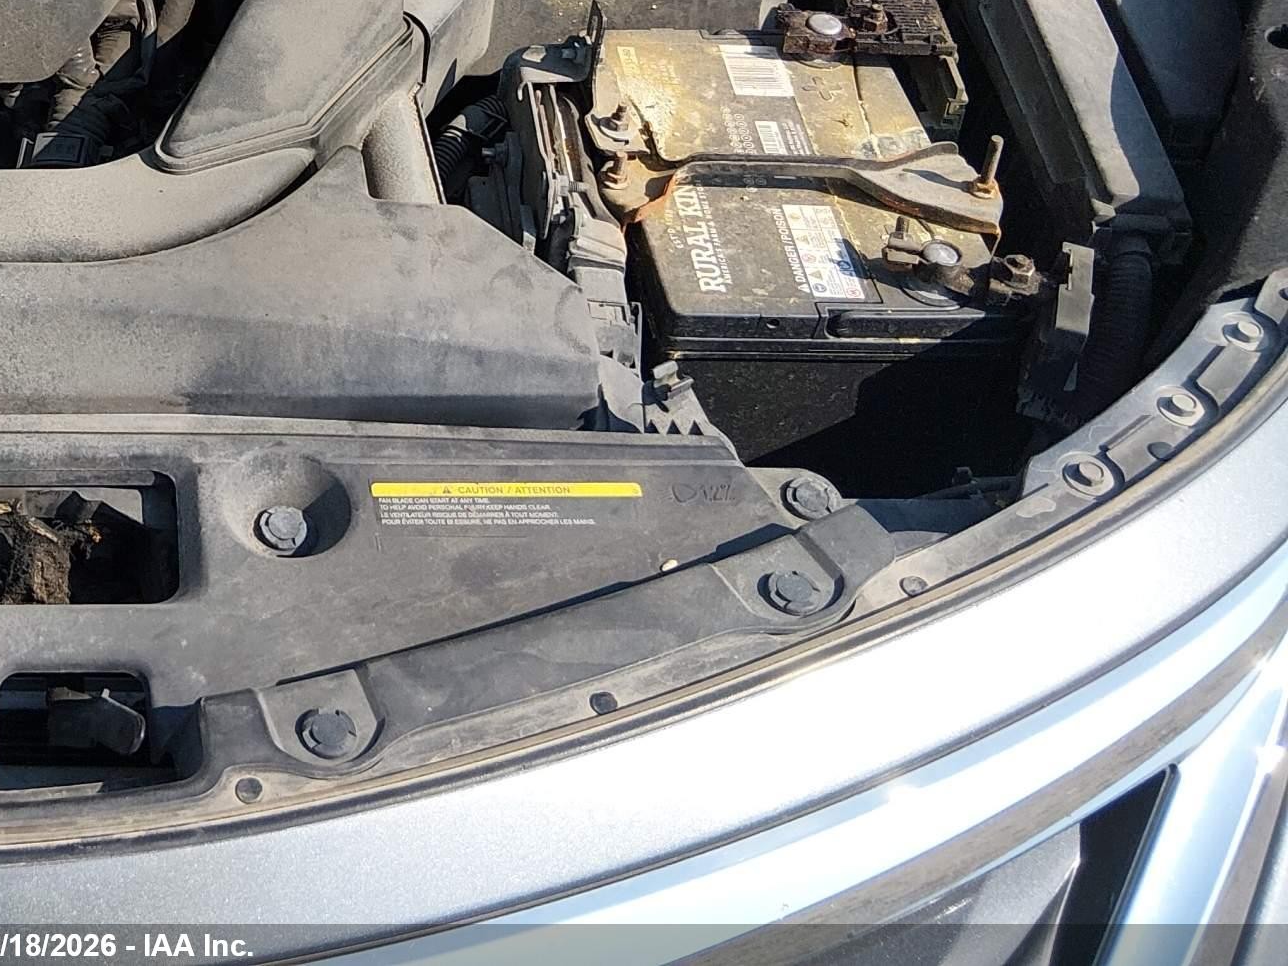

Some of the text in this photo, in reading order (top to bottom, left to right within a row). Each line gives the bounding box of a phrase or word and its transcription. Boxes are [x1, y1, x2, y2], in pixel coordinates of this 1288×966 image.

[701, 200, 712, 219] HOME
[710, 228, 721, 246] FARM
[683, 222, 726, 293] RURAL
[716, 247, 733, 284] AMERICA'S
